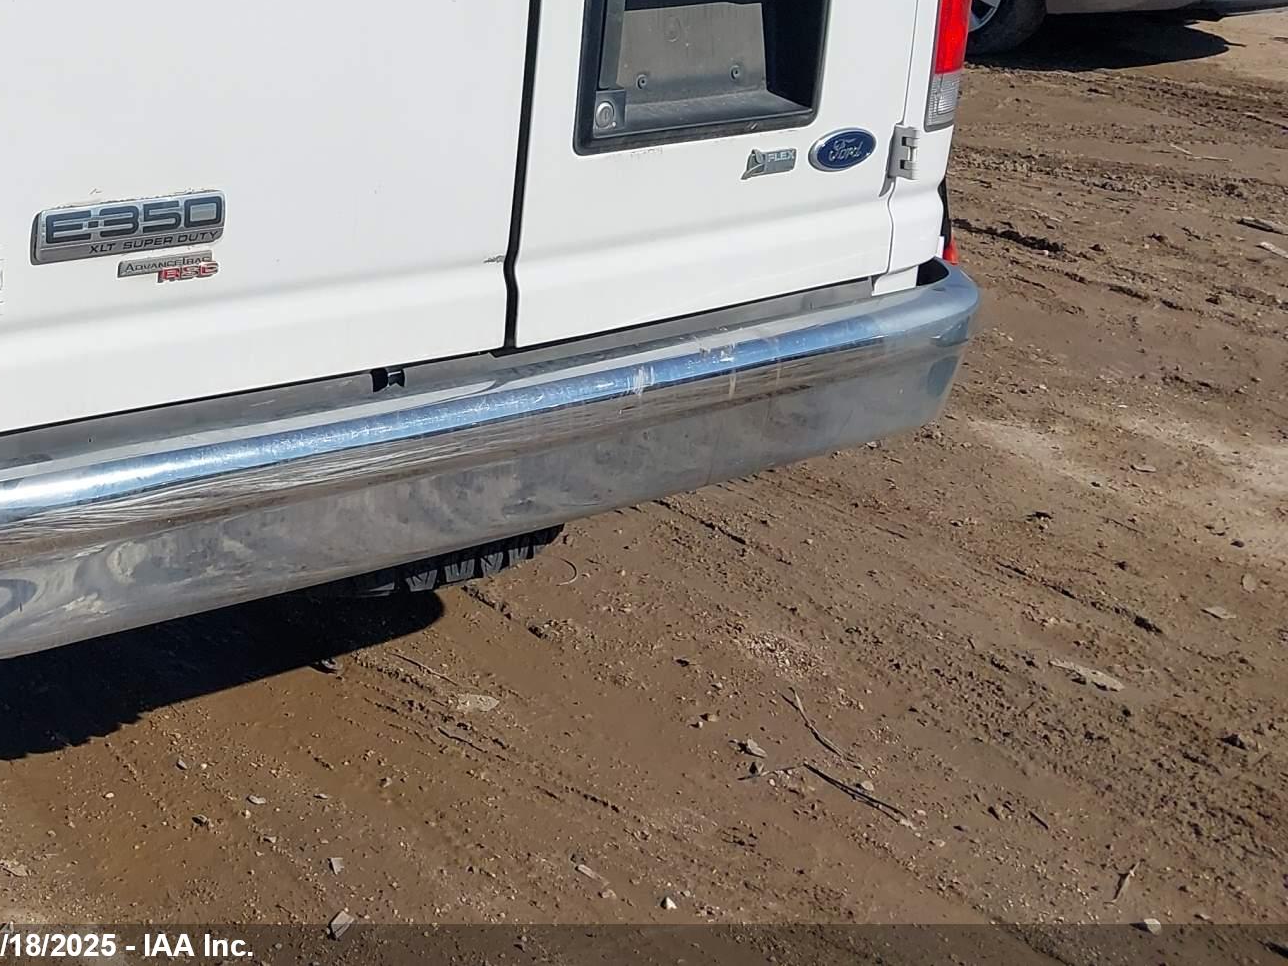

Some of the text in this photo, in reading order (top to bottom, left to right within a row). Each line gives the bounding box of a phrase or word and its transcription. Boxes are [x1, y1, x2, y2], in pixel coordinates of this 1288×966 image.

[767, 150, 795, 163] FLEX
[828, 138, 863, 161] Ford
[89, 230, 218, 254] XLT SUPER DUTY
[158, 261, 219, 283] RSC
